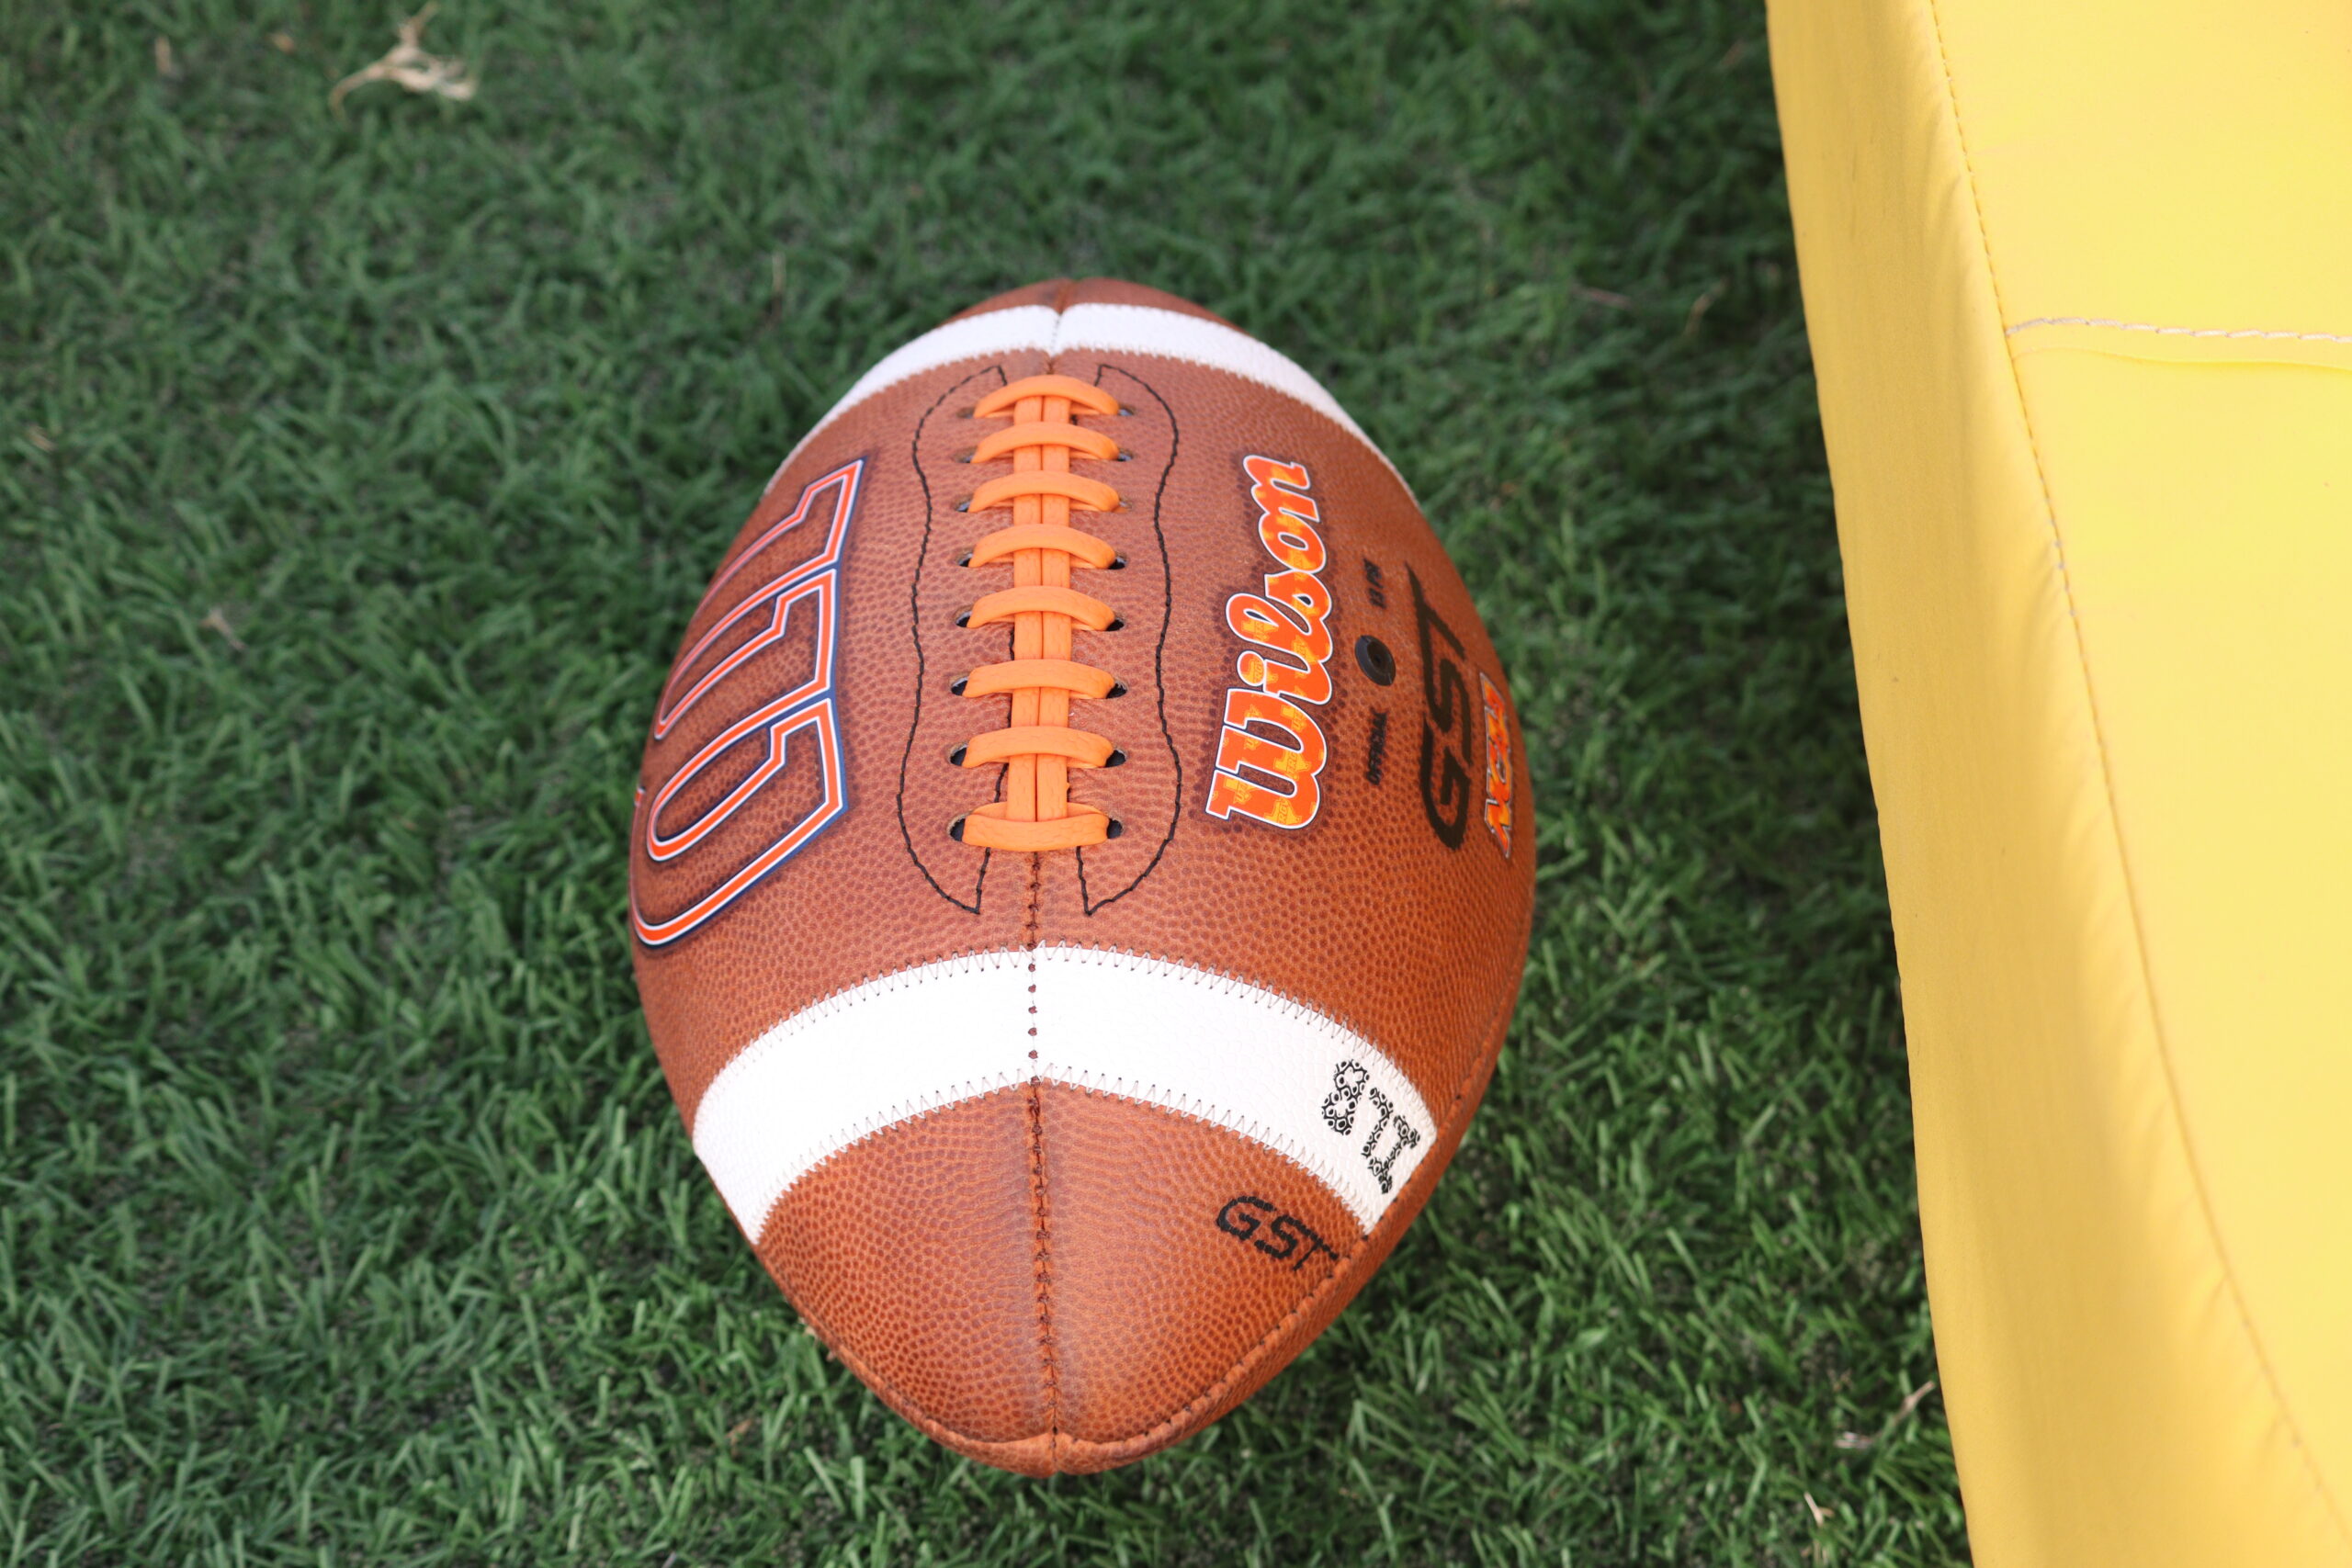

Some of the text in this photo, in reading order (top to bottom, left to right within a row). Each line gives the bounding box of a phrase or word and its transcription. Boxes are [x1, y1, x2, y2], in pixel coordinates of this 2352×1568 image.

[1204, 455, 1334, 830] Wilson
[1405, 559, 1472, 852] GST
[1366, 706, 1388, 786] OFFICIAL
[1479, 671, 1512, 860] NCAA
[1215, 1195, 1340, 1272] GST
